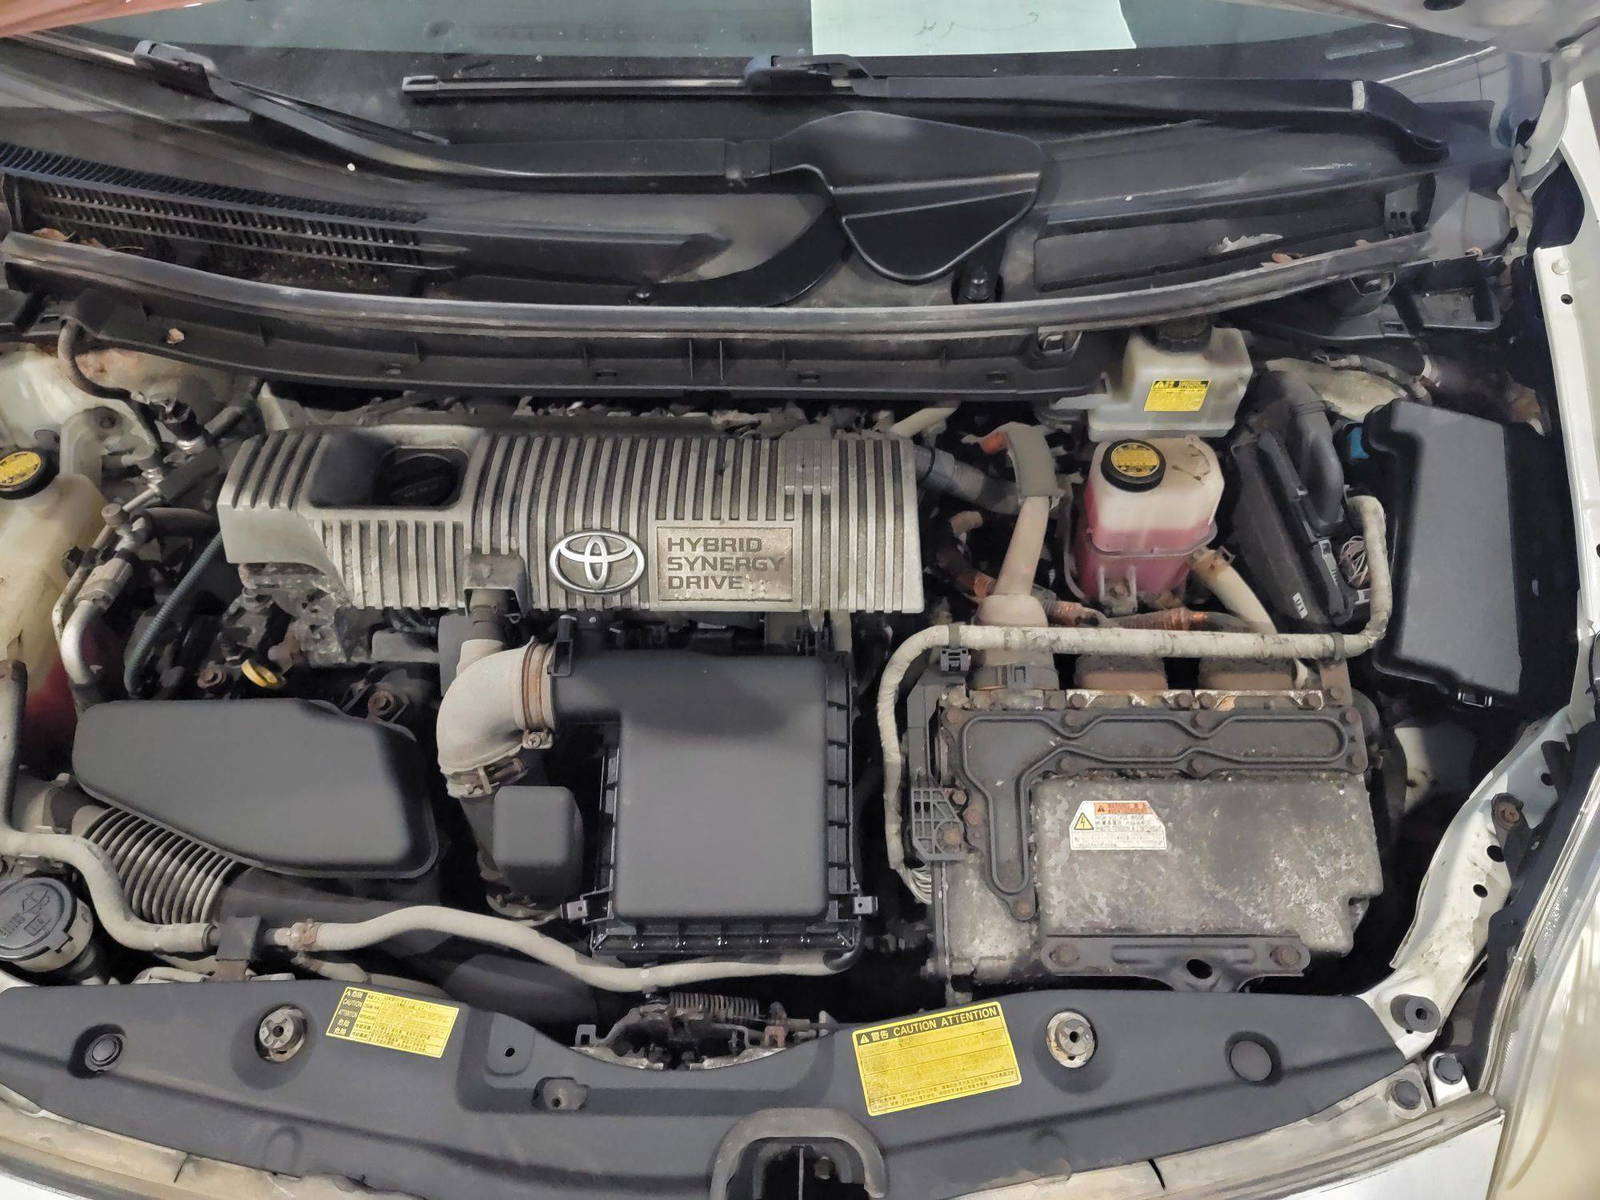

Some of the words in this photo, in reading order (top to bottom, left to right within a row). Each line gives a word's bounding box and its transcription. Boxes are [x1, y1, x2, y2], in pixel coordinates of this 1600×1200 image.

[667, 537, 762, 552] HYBRID
[667, 556, 785, 571] SYNERGY
[667, 575, 743, 590] DRIVE
[893, 1019, 937, 1037] CAUTION
[941, 1006, 997, 1027] ATTENTION
